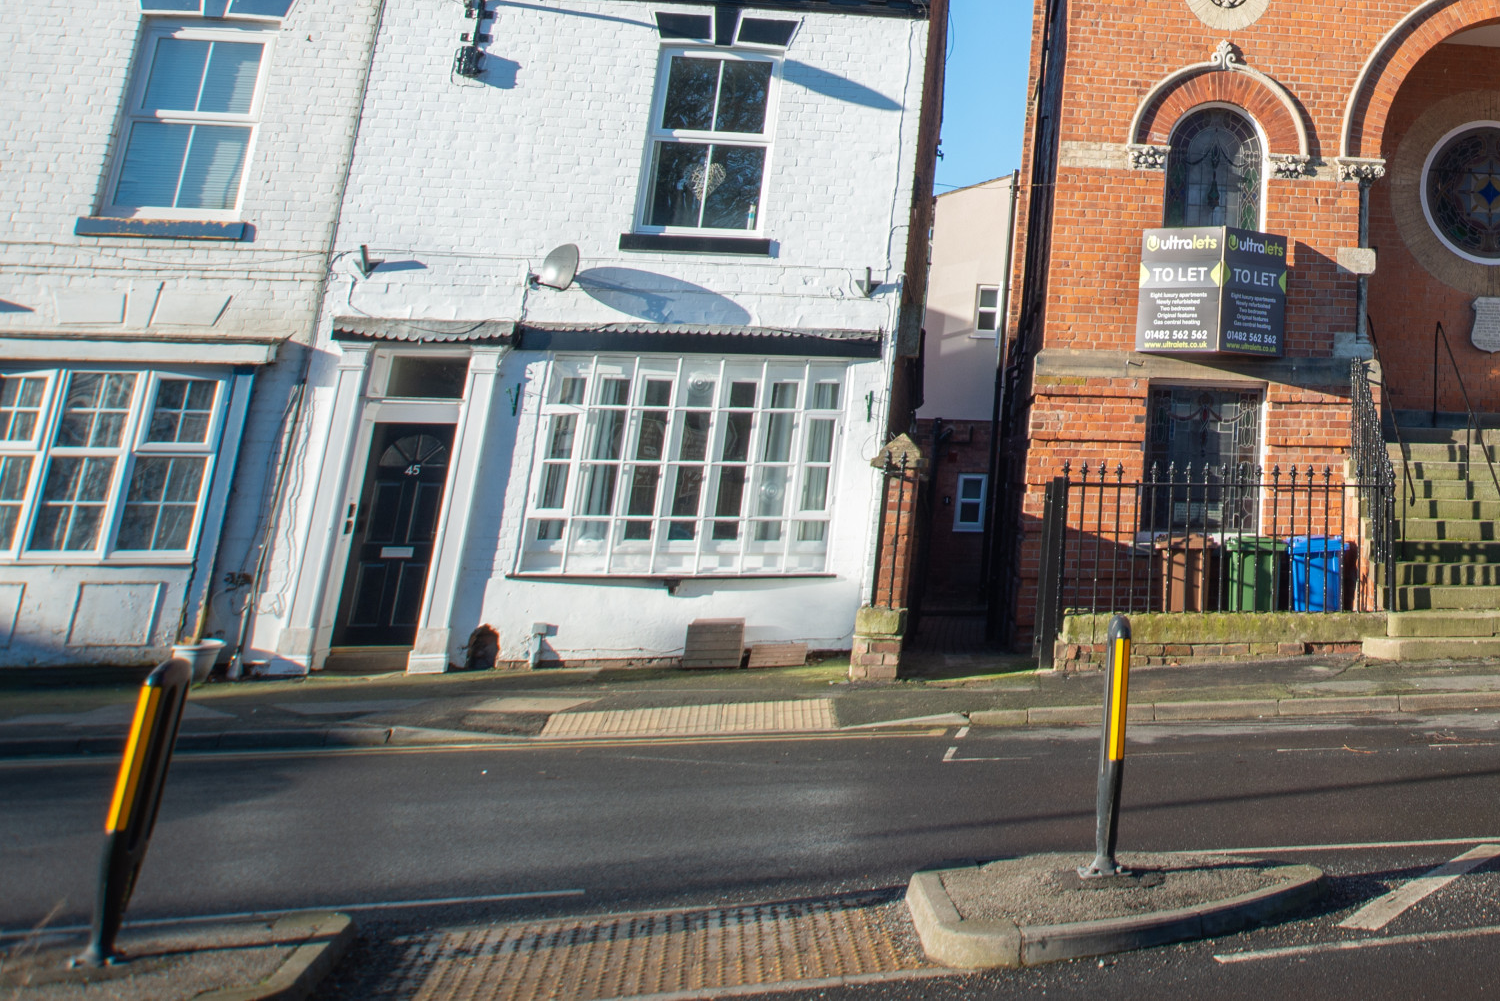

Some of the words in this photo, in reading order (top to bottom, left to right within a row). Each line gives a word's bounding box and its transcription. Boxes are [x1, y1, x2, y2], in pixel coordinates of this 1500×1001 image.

[1161, 234, 1217, 250] ultralets
[1239, 237, 1283, 257] ultralets
[1153, 267, 1174, 282] TO
[1178, 267, 1208, 282] LET
[1234, 268, 1251, 284] TO
[1254, 270, 1277, 287] LET
[1144, 330, 1170, 339] 01482
[1172, 330, 1188, 339] 562
[1191, 330, 1208, 339] 562
[1226, 330, 1247, 341] 01482
[1248, 332, 1261, 343] 562
[1263, 334, 1277, 344] 562
[404, 464, 421, 475] 45
